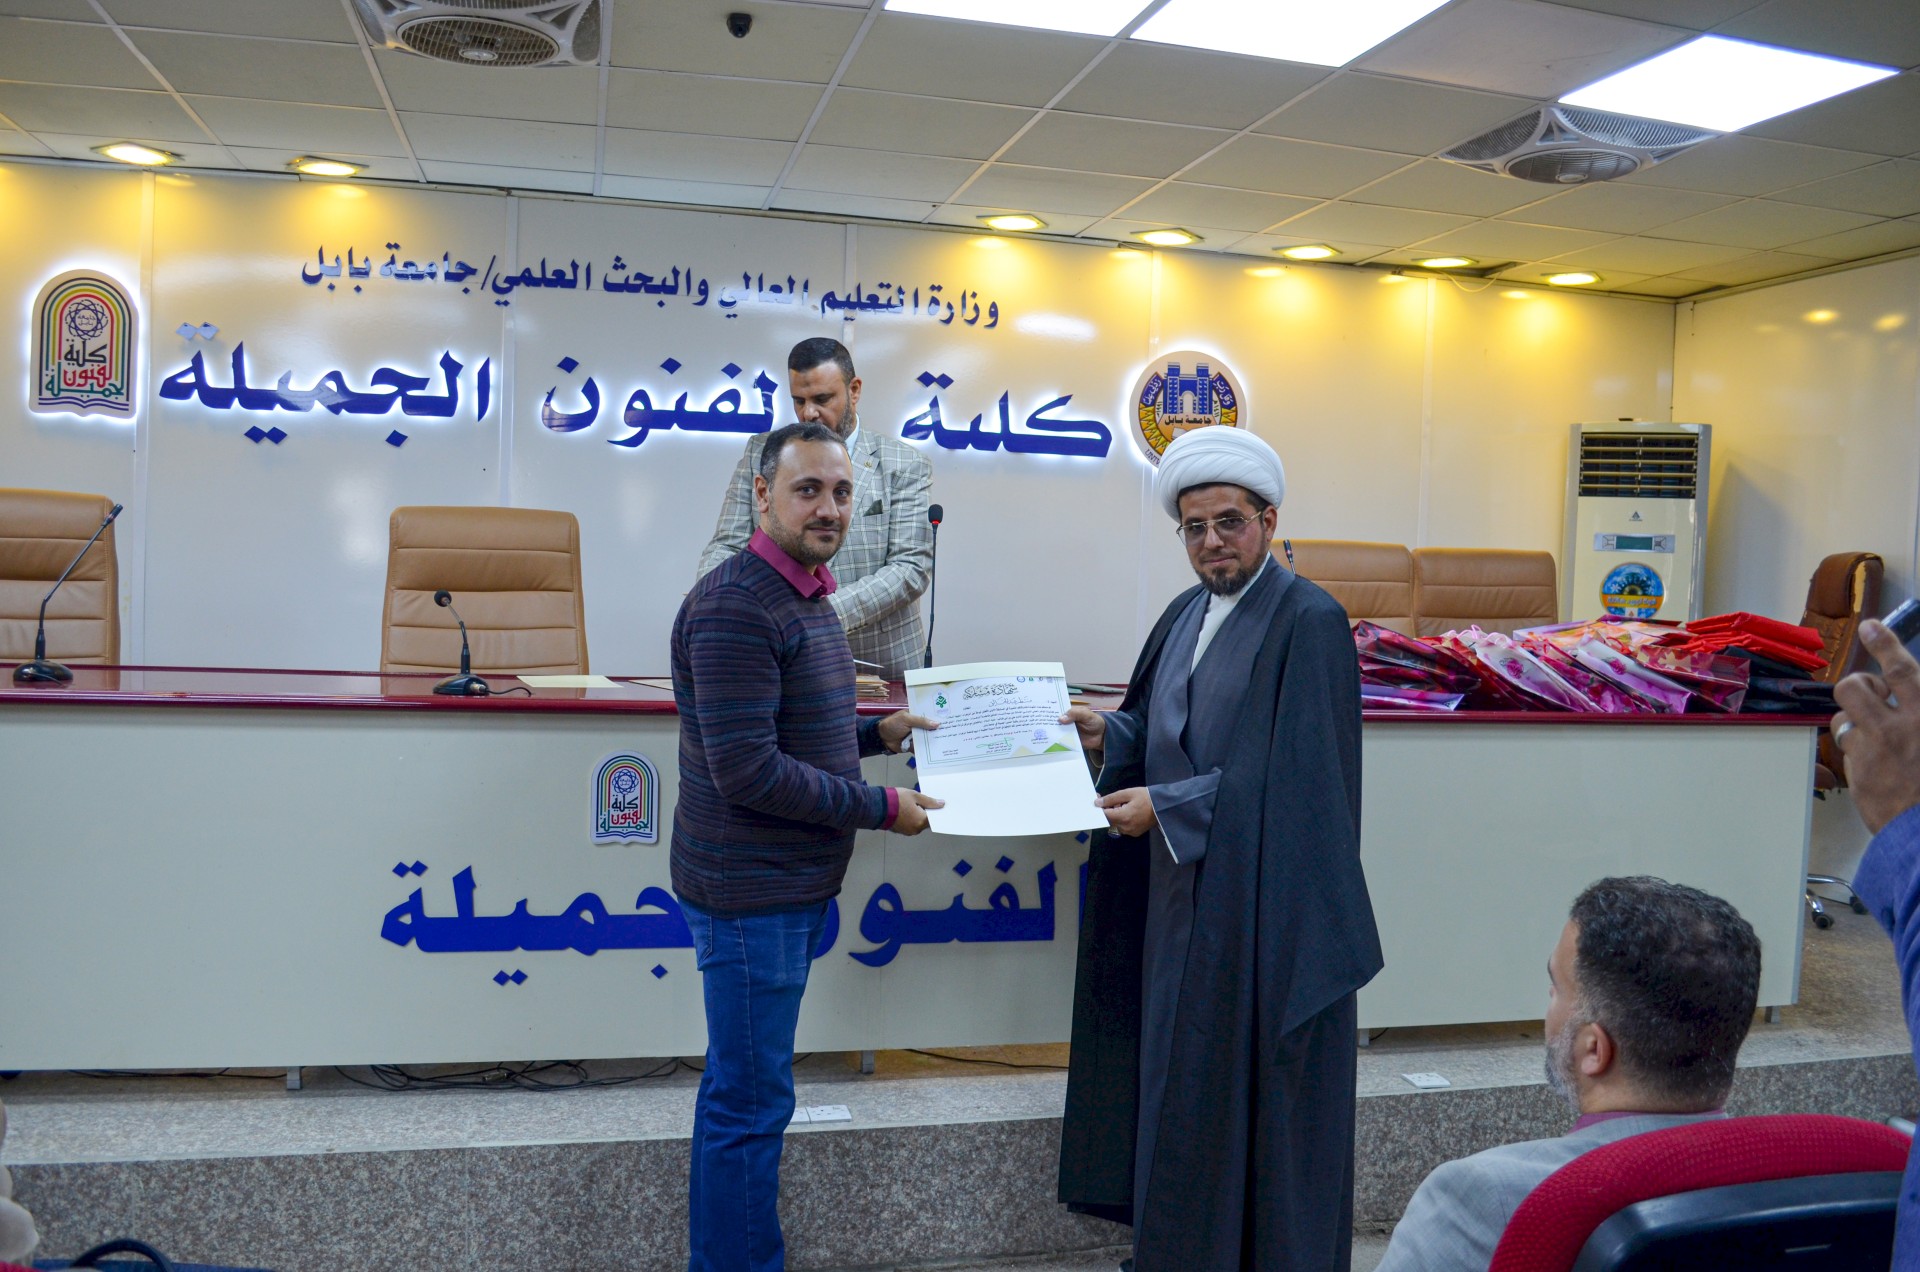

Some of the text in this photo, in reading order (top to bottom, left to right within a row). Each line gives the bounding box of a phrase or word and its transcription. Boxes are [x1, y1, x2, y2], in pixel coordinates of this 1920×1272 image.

[302, 245, 372, 293] بابل
[602, 255, 709, 306] والبحث
[718, 271, 809, 318] العالي
[820, 281, 919, 321] التعليم
[928, 284, 999, 328] وزارة
[63, 338, 107, 368] كلية
[159, 321, 491, 447] الجميلة
[541, 356, 779, 448] لفنون
[1164, 415, 1212, 427] جامعة بابل
[611, 794, 639, 812] كلية
[380, 860, 695, 986] جميلة
